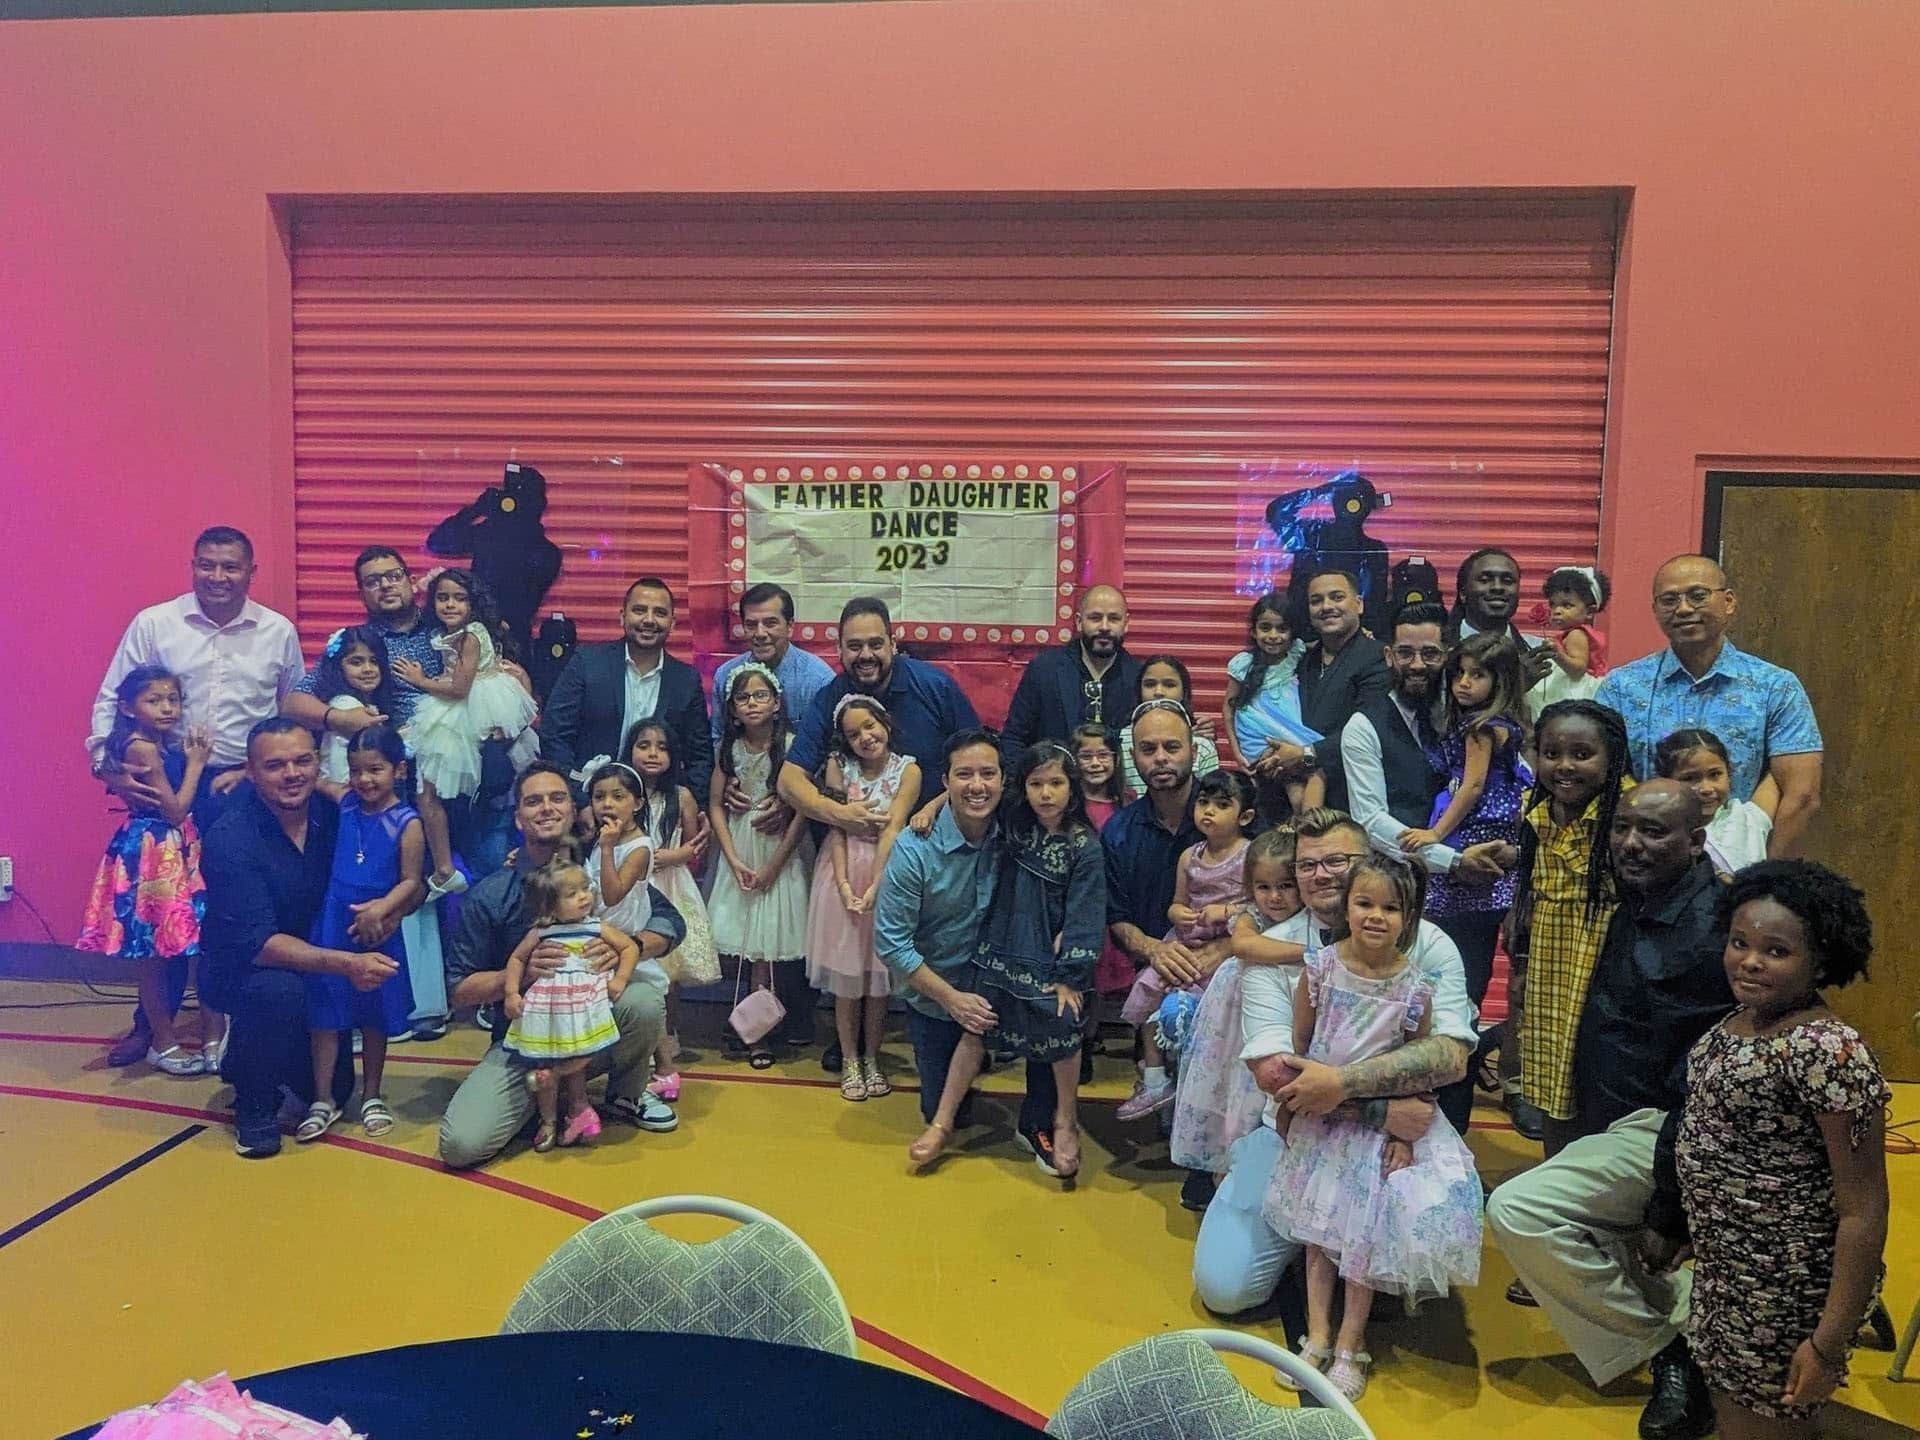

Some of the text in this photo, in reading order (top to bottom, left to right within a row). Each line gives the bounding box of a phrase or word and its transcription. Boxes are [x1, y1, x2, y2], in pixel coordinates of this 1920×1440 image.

[774, 482, 1048, 509] FATHER DAUGHTER
[871, 511, 958, 538] DANCE
[877, 541, 949, 571] 2023
